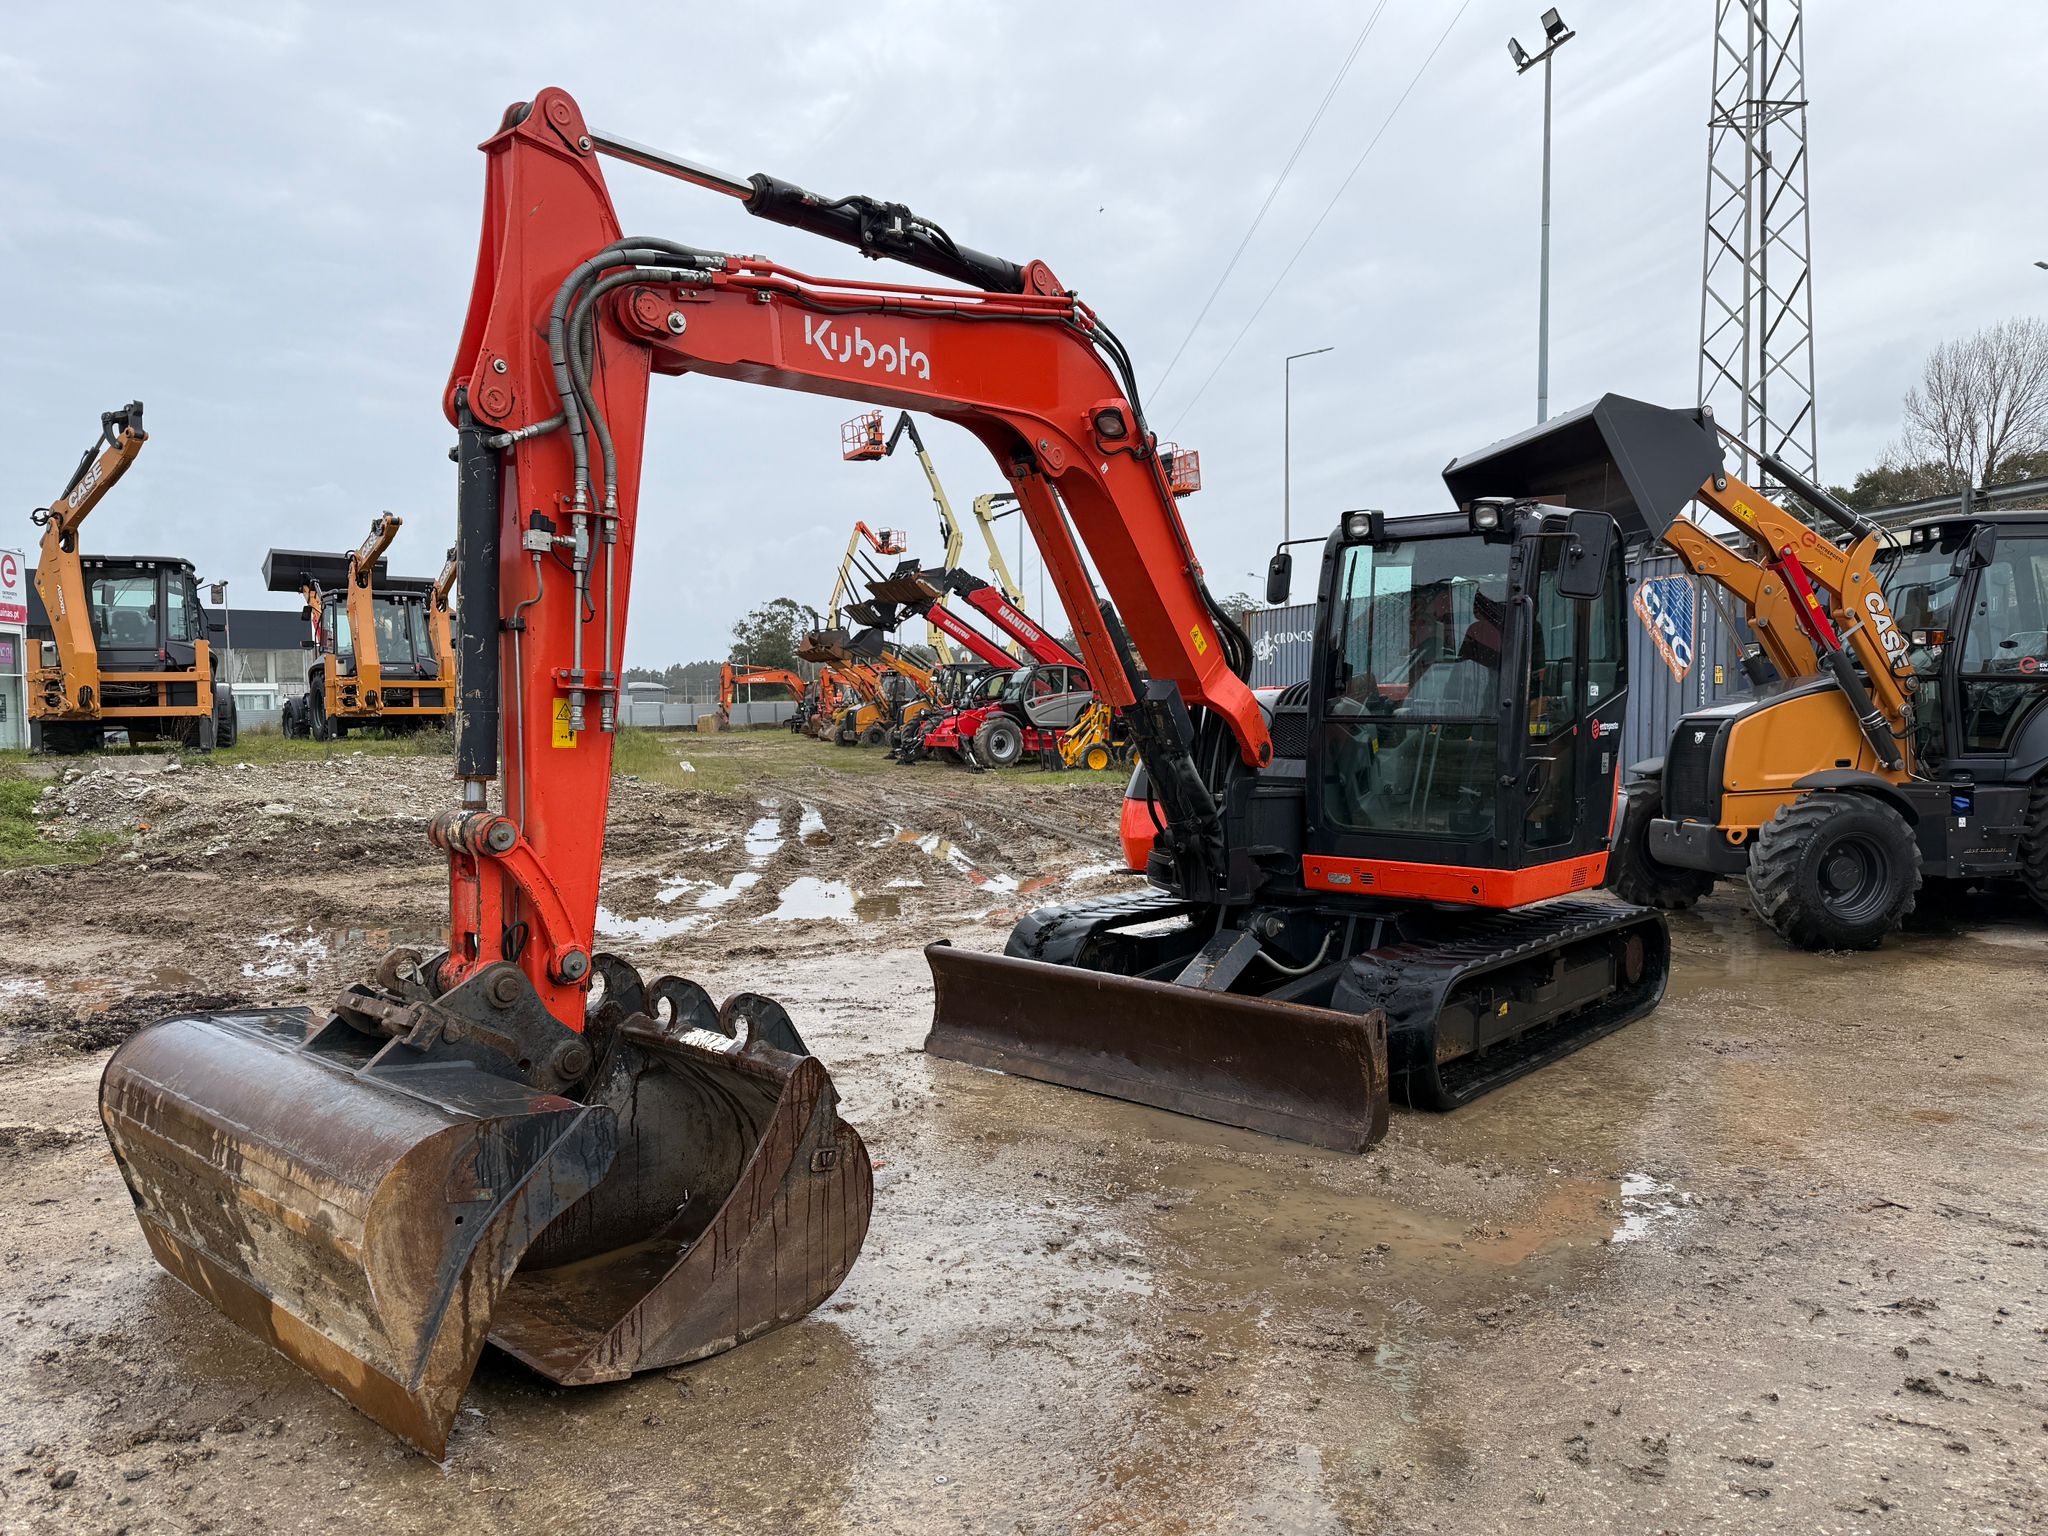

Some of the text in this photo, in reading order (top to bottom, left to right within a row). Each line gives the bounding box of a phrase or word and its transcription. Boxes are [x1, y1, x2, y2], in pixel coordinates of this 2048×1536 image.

[805, 315, 930, 380] Kubota
[69, 460, 103, 508] CASE
[1816, 543, 1844, 563] ENTREPOSTO
[943, 618, 970, 640] MANITOU
[998, 605, 1040, 642] MANITOU
[1273, 630, 1313, 644] CRONOS
[1865, 591, 1909, 669] CASE
